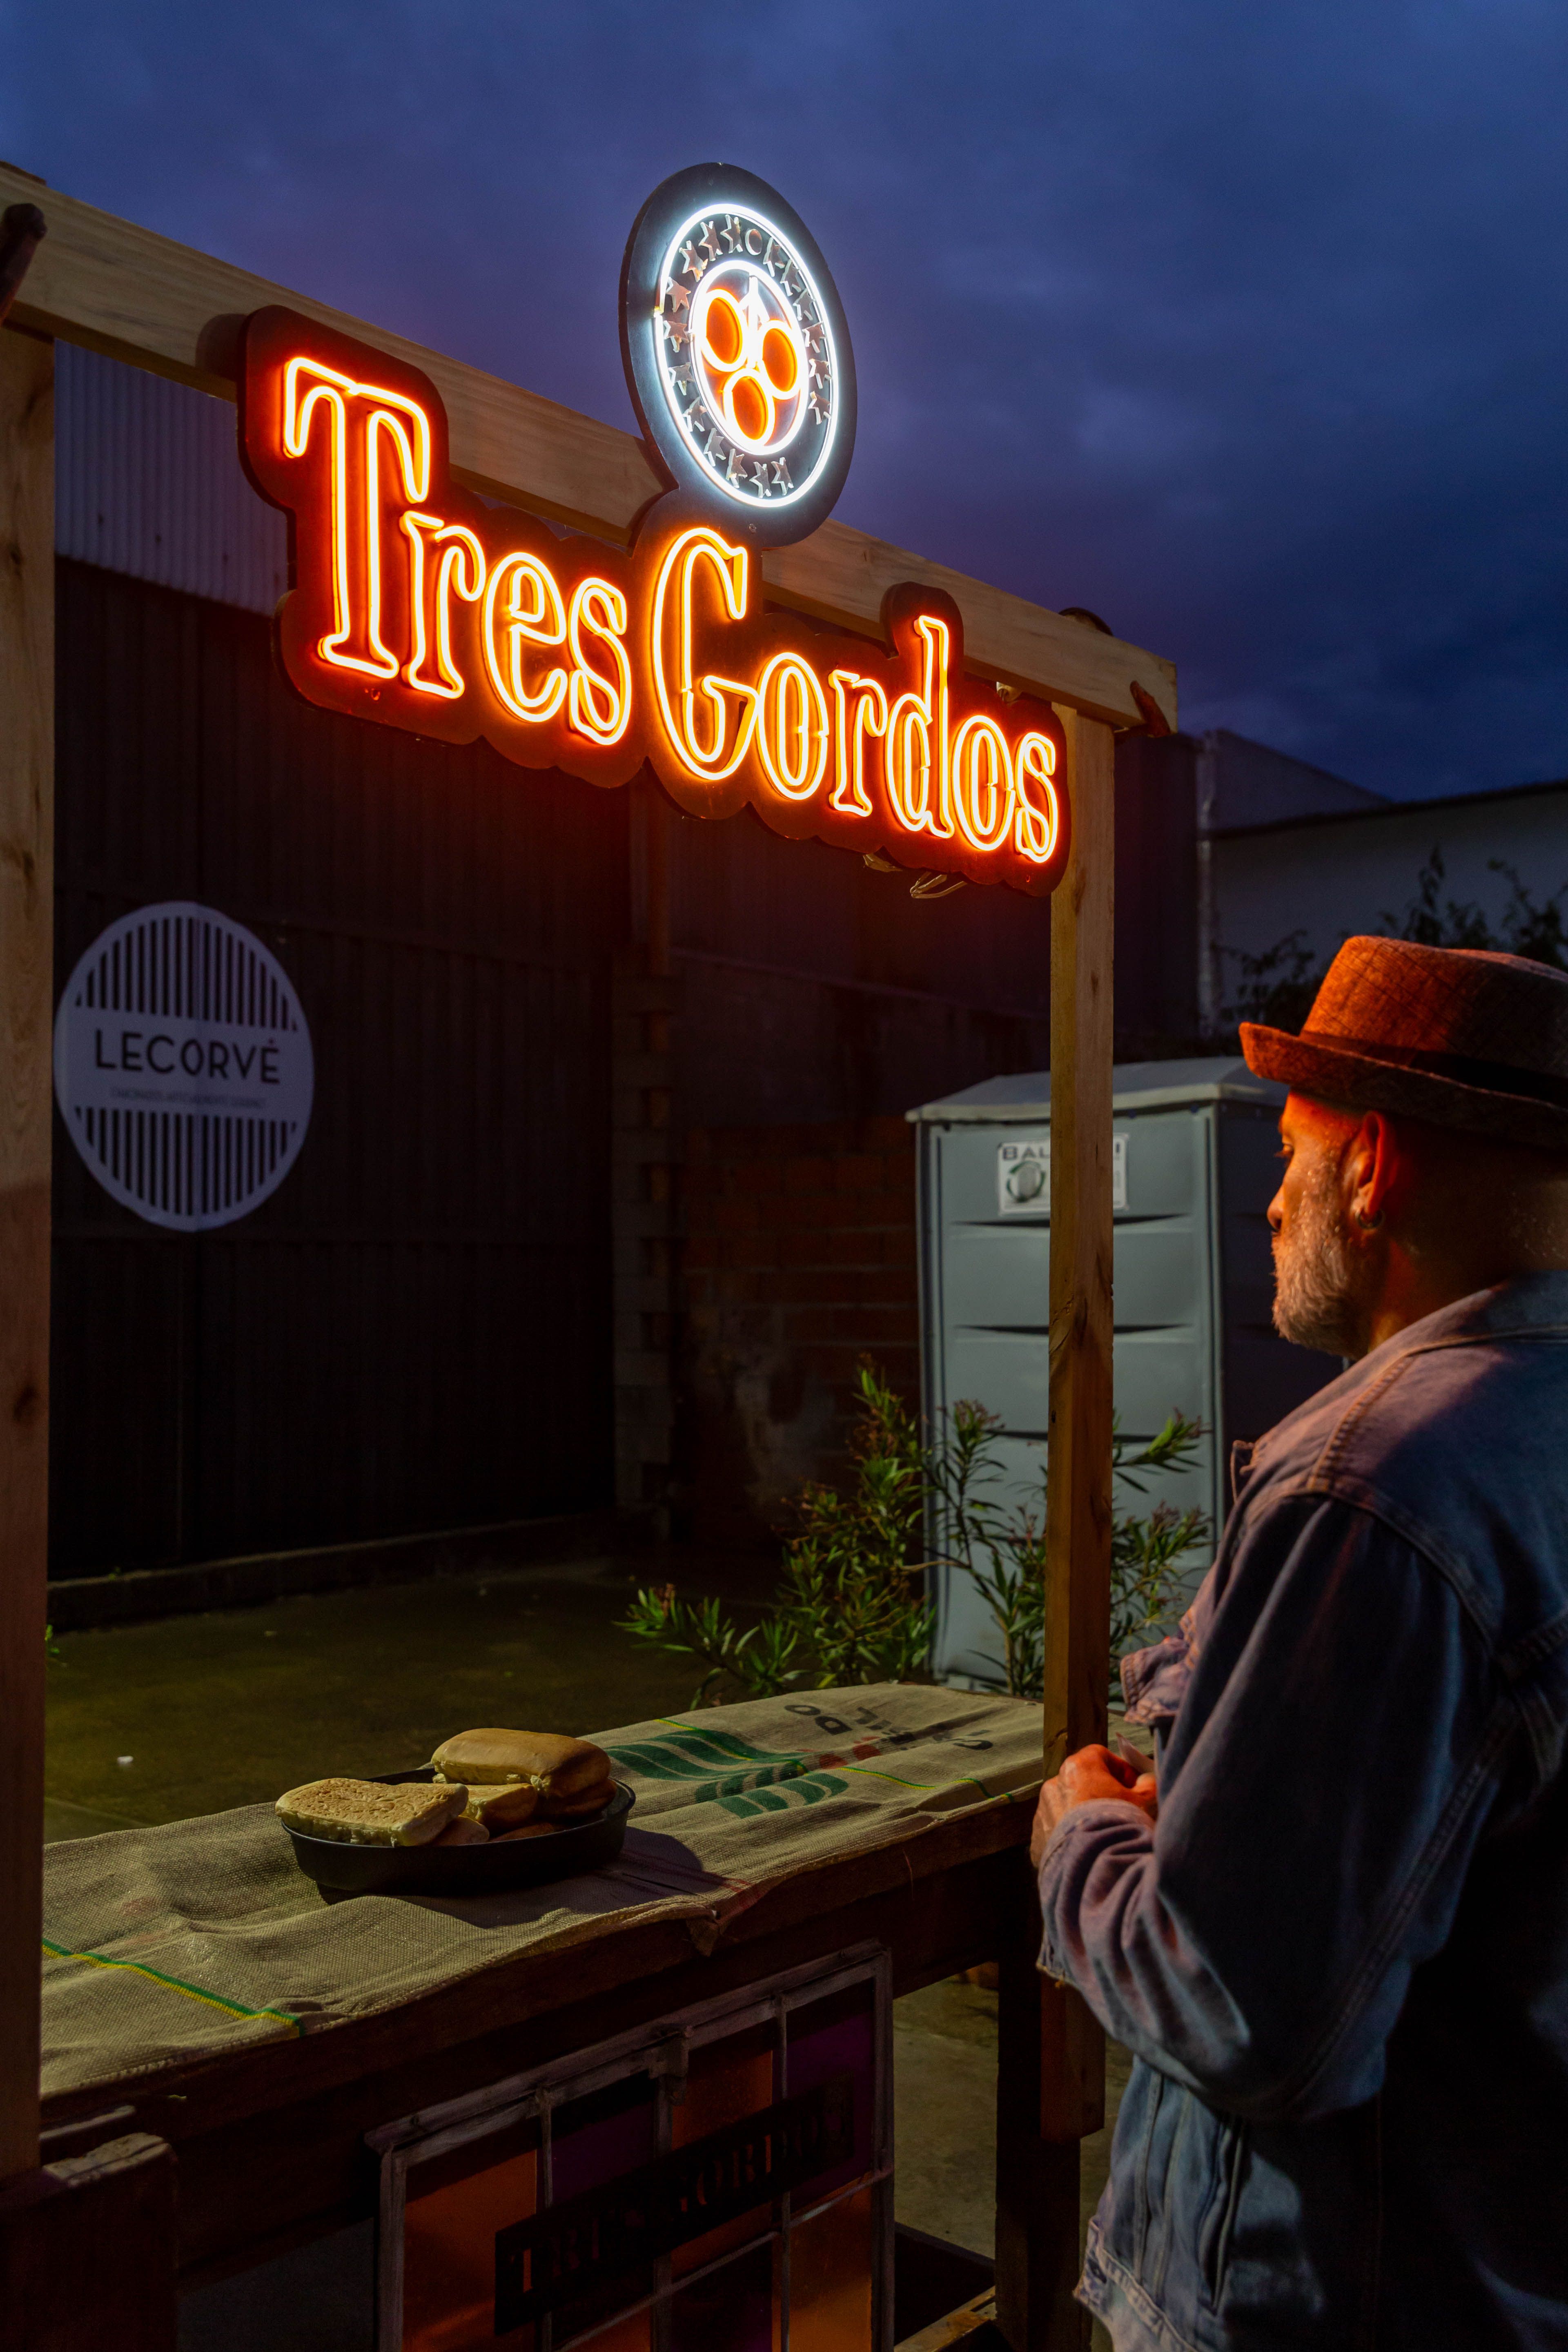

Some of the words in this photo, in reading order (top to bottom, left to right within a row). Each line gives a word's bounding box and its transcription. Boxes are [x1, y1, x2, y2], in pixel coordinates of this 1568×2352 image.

[283, 356, 633, 747] Tres
[651, 525, 1059, 864] Gordos
[95, 1029, 281, 1085] LECORVÉ
